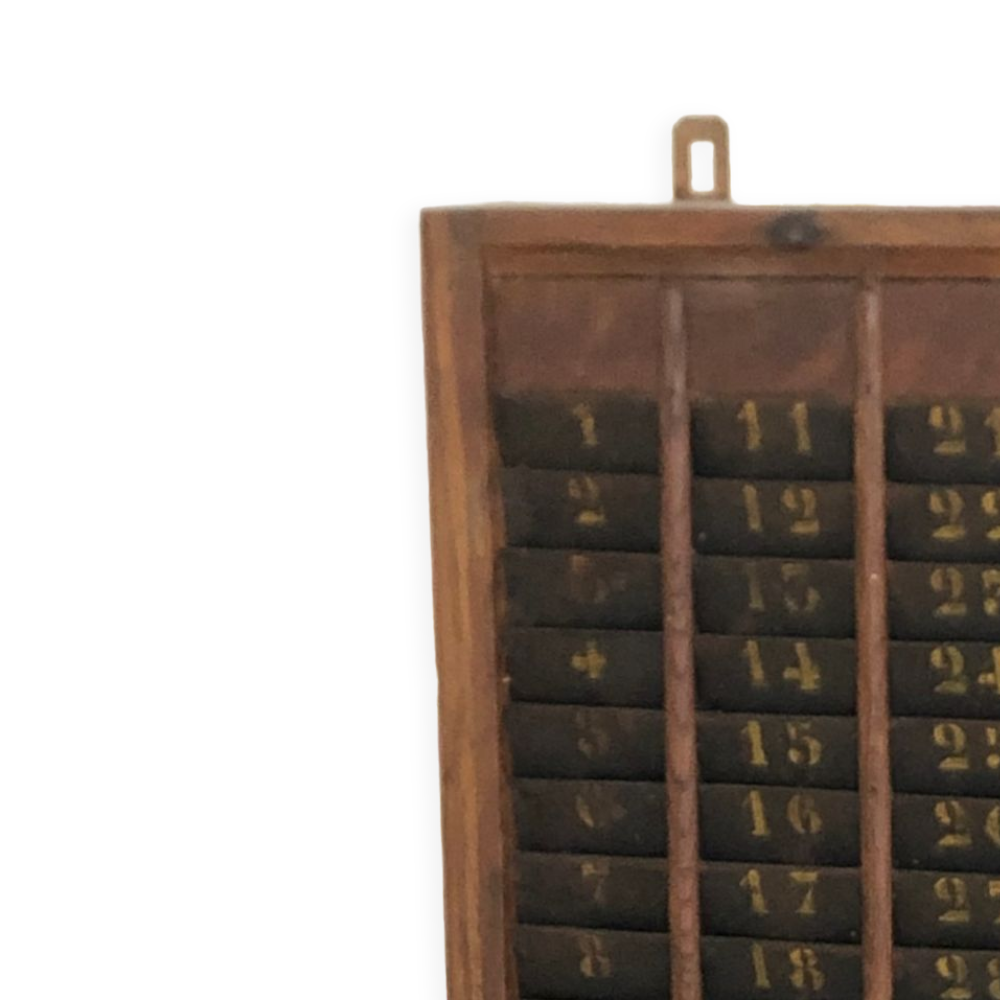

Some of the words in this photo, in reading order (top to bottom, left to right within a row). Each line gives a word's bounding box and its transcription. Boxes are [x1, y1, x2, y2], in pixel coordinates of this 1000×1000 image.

[573, 403, 598, 447] 1
[737, 401, 813, 456] 11
[568, 476, 607, 528] 2
[741, 484, 821, 536] 12
[570, 641, 607, 681] 4
[742, 639, 821, 692] 14
[740, 719, 822, 767] 15
[742, 790, 823, 838] 16
[739, 868, 819, 916] 17
[579, 934, 612, 980] 8
[749, 942, 826, 992] 18
